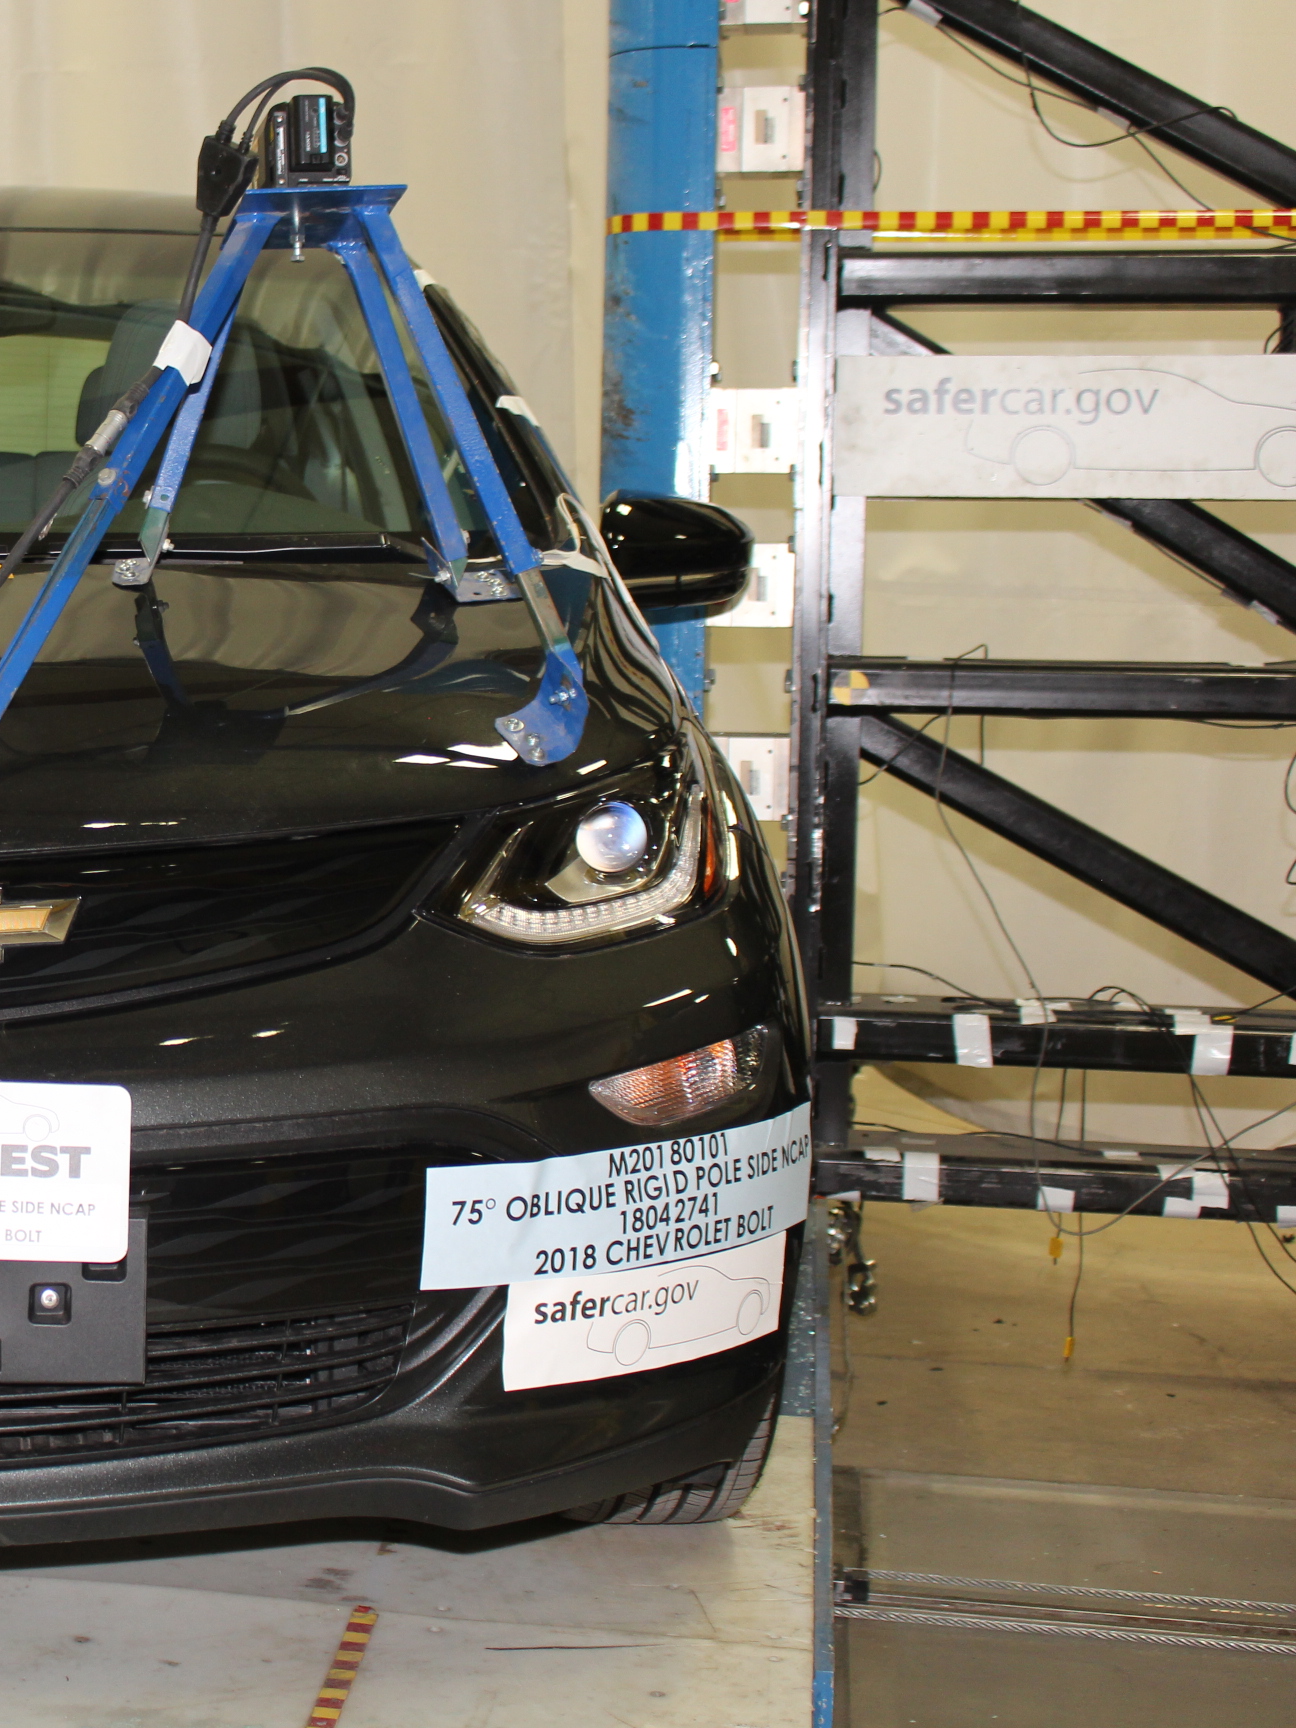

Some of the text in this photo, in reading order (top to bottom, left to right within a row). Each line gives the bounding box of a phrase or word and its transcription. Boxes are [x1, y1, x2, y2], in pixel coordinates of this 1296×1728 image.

[883, 377, 1160, 425] safercar.gov
[609, 1132, 728, 1178] M20180101
[451, 1135, 809, 1226] 75° OBLIQUE RIGID POLE SIDE NCAP
[12, 1201, 45, 1214] SIDE
[50, 1203, 96, 1216] NCAP
[620, 1193, 719, 1235] 18042741
[5, 1229, 42, 1243] BOLT
[534, 1205, 774, 1275] 2018 CHEVROLET BOLT
[534, 1280, 699, 1324] safercar.gov
